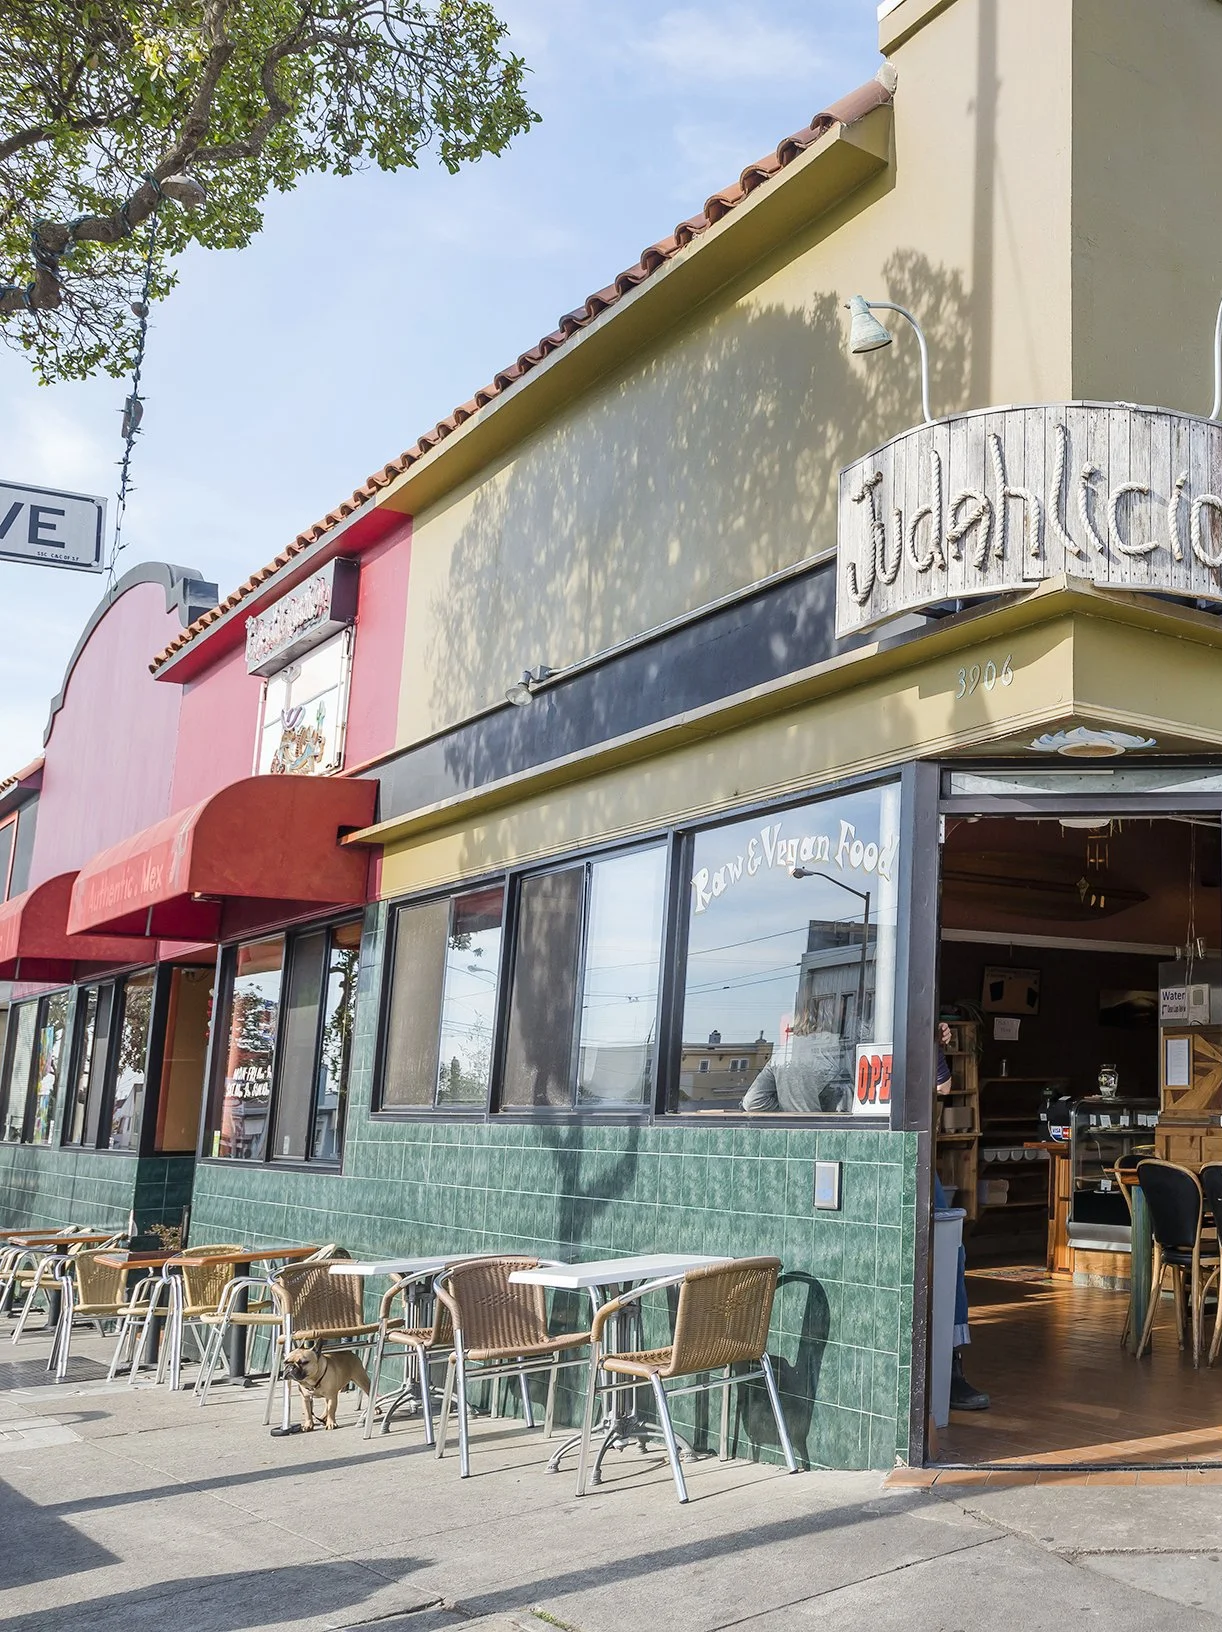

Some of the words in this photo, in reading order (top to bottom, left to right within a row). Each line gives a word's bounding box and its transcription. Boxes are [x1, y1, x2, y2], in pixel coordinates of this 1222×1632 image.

[954, 653, 1014, 700] 3906
[140, 855, 164, 895] Mex
[690, 855, 745, 915] Raw
[746, 837, 763, 876] &
[760, 822, 831, 879] Vegan
[835, 819, 900, 881] Food
[1162, 991, 1186, 1001] Water
